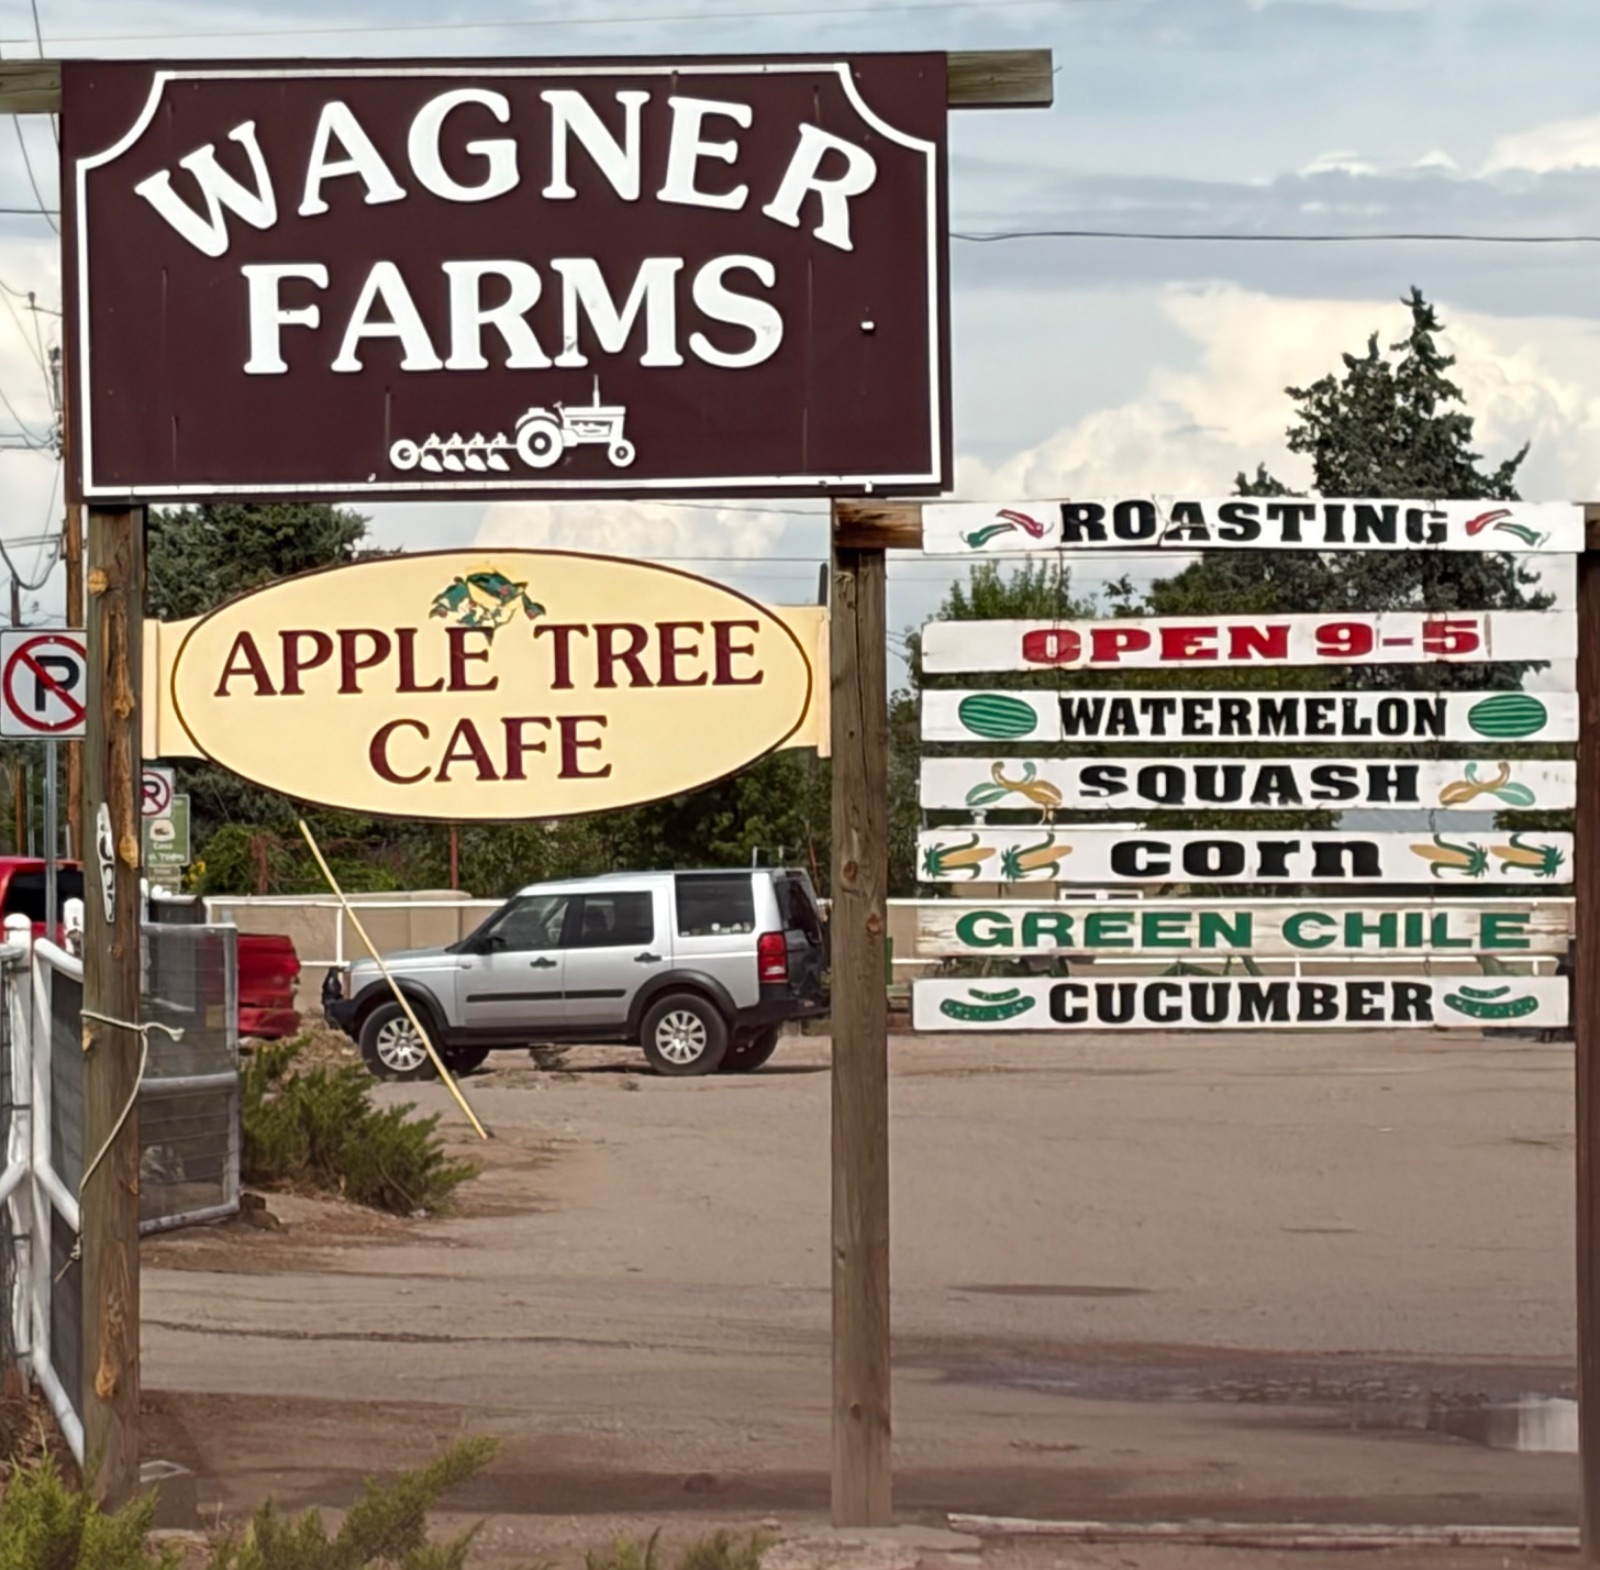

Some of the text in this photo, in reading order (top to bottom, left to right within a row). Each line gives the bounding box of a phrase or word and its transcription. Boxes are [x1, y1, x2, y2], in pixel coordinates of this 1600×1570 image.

[135, 88, 877, 257] WAGNER
[241, 254, 784, 374] FARMS
[1060, 499, 1449, 544] ROASTING
[213, 620, 764, 697] APPLE TREE
[1022, 619, 1480, 664] OPEN 9-5
[1058, 696, 1447, 737] WATERMELON
[369, 714, 612, 785] CAFE
[1079, 764, 1420, 805] SQUASH
[1110, 840, 1383, 878] corn
[956, 911, 1531, 949] GREEN CHILE
[1048, 980, 1434, 1024] CUCUMBER
